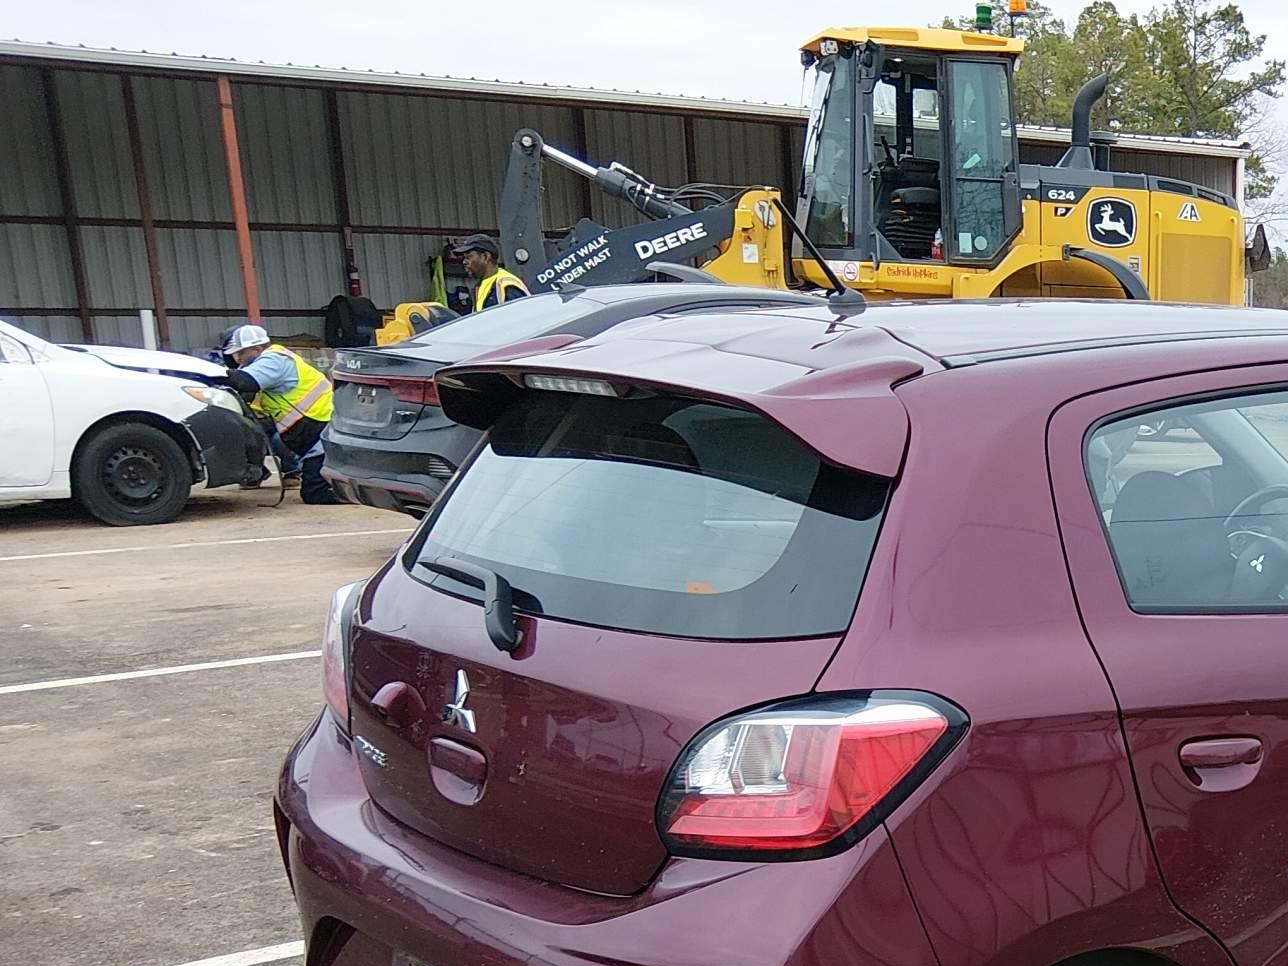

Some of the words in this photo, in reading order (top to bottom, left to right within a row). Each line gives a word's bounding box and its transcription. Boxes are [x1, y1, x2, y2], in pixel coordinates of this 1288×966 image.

[1047, 188, 1076, 201] 624
[634, 222, 707, 260] DEERE
[536, 268, 555, 284] DO
[553, 253, 577, 273] NOT
[576, 234, 609, 258] WALK
[583, 247, 612, 270] MAST
